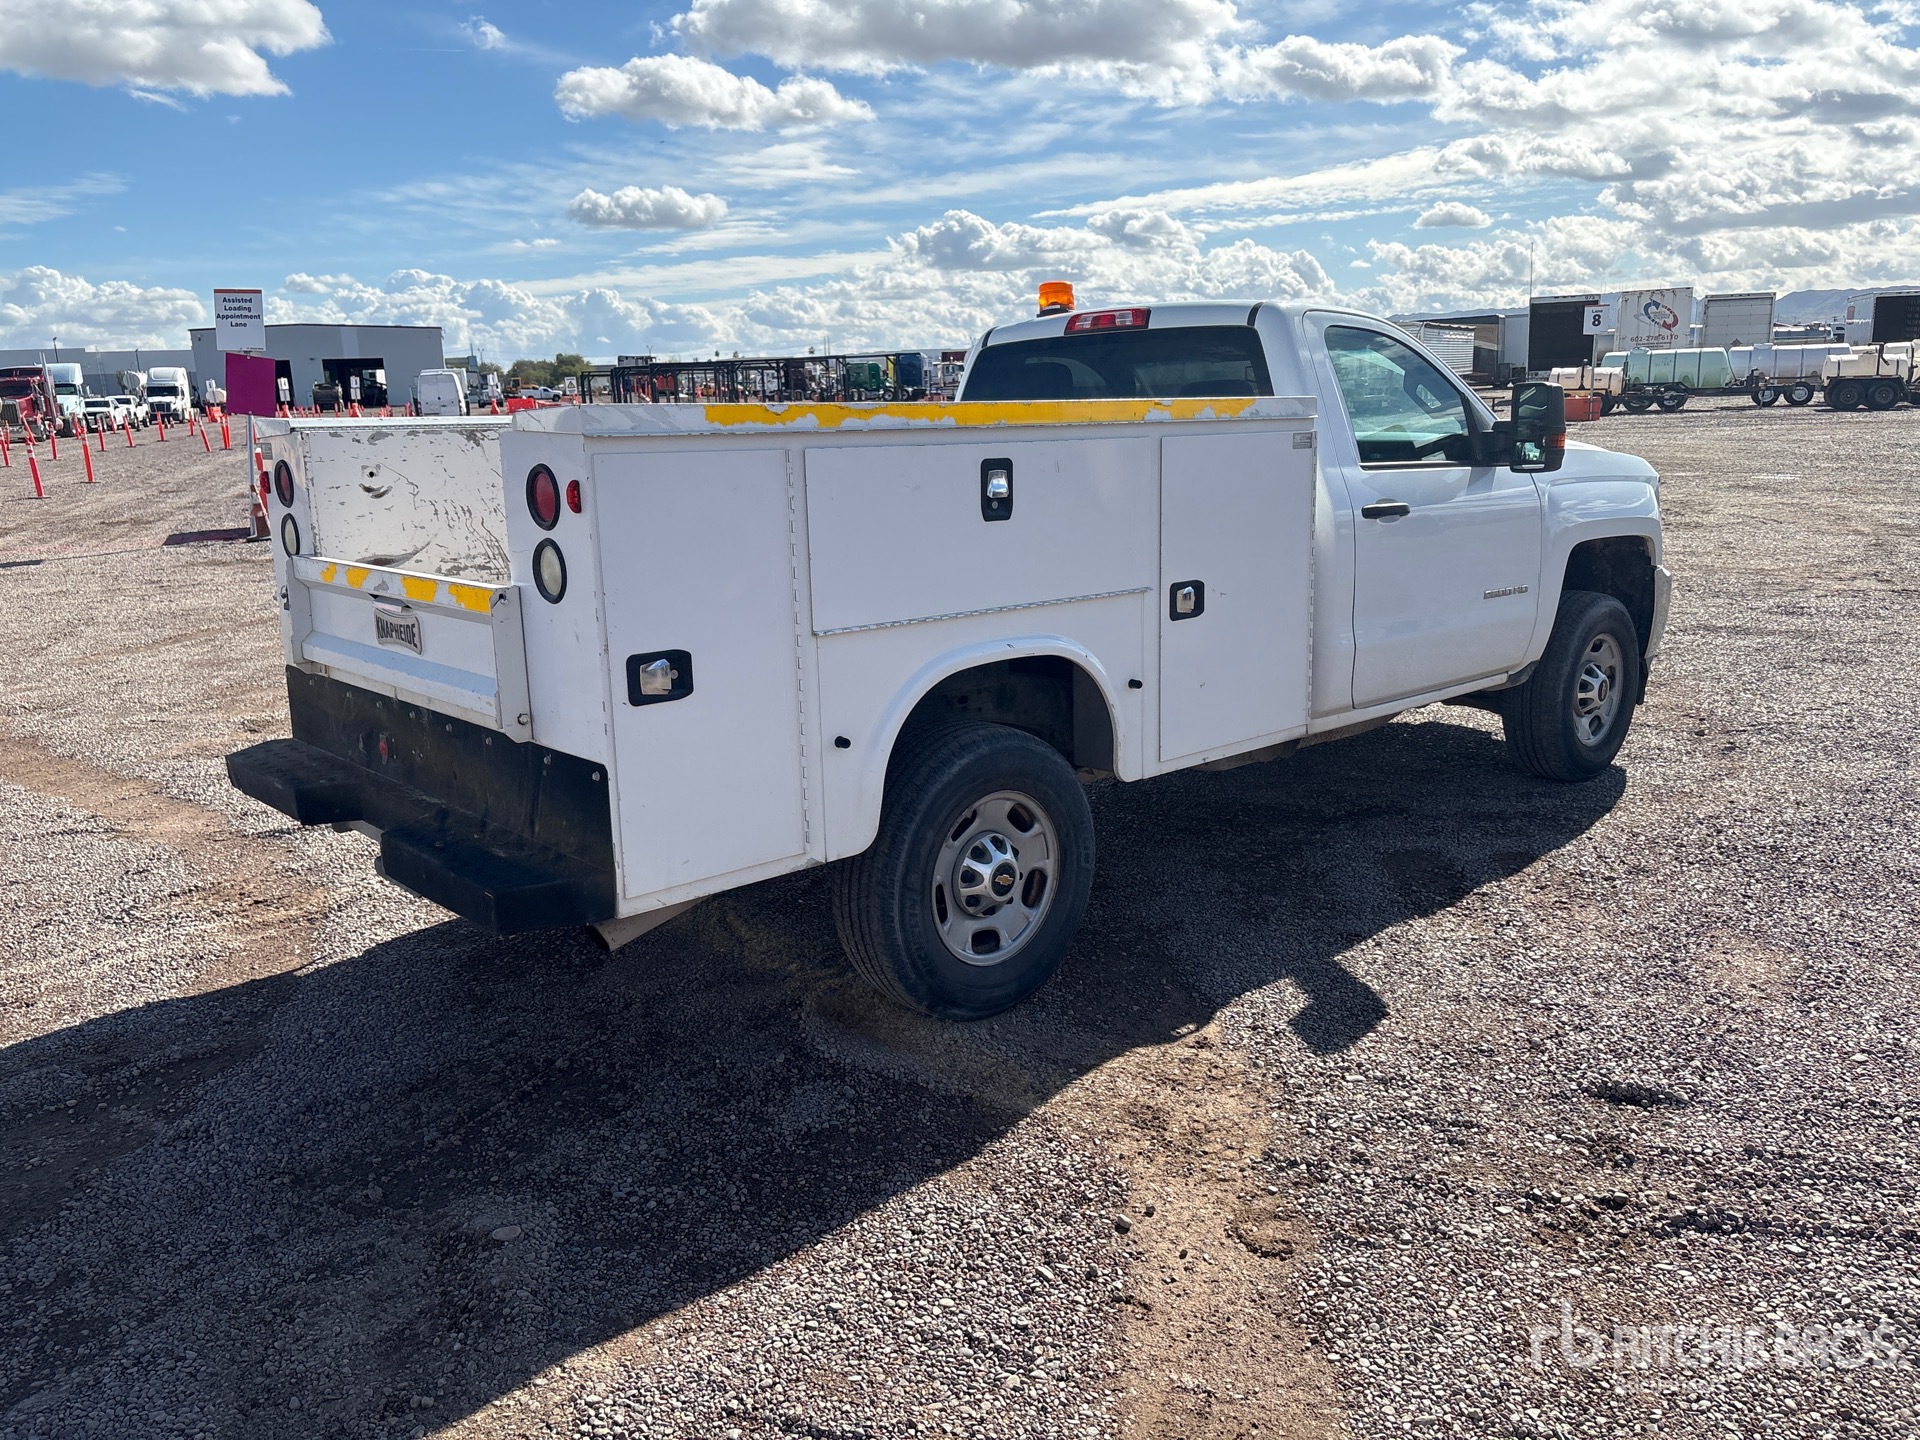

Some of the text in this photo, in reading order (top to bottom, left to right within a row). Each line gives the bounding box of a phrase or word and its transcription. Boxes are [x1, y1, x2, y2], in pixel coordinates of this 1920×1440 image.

[222, 296, 253, 304] Assisted
[223, 305, 252, 313] Loading
[1591, 313, 1602, 327] 8
[375, 614, 418, 649] KNAPHEIDE
